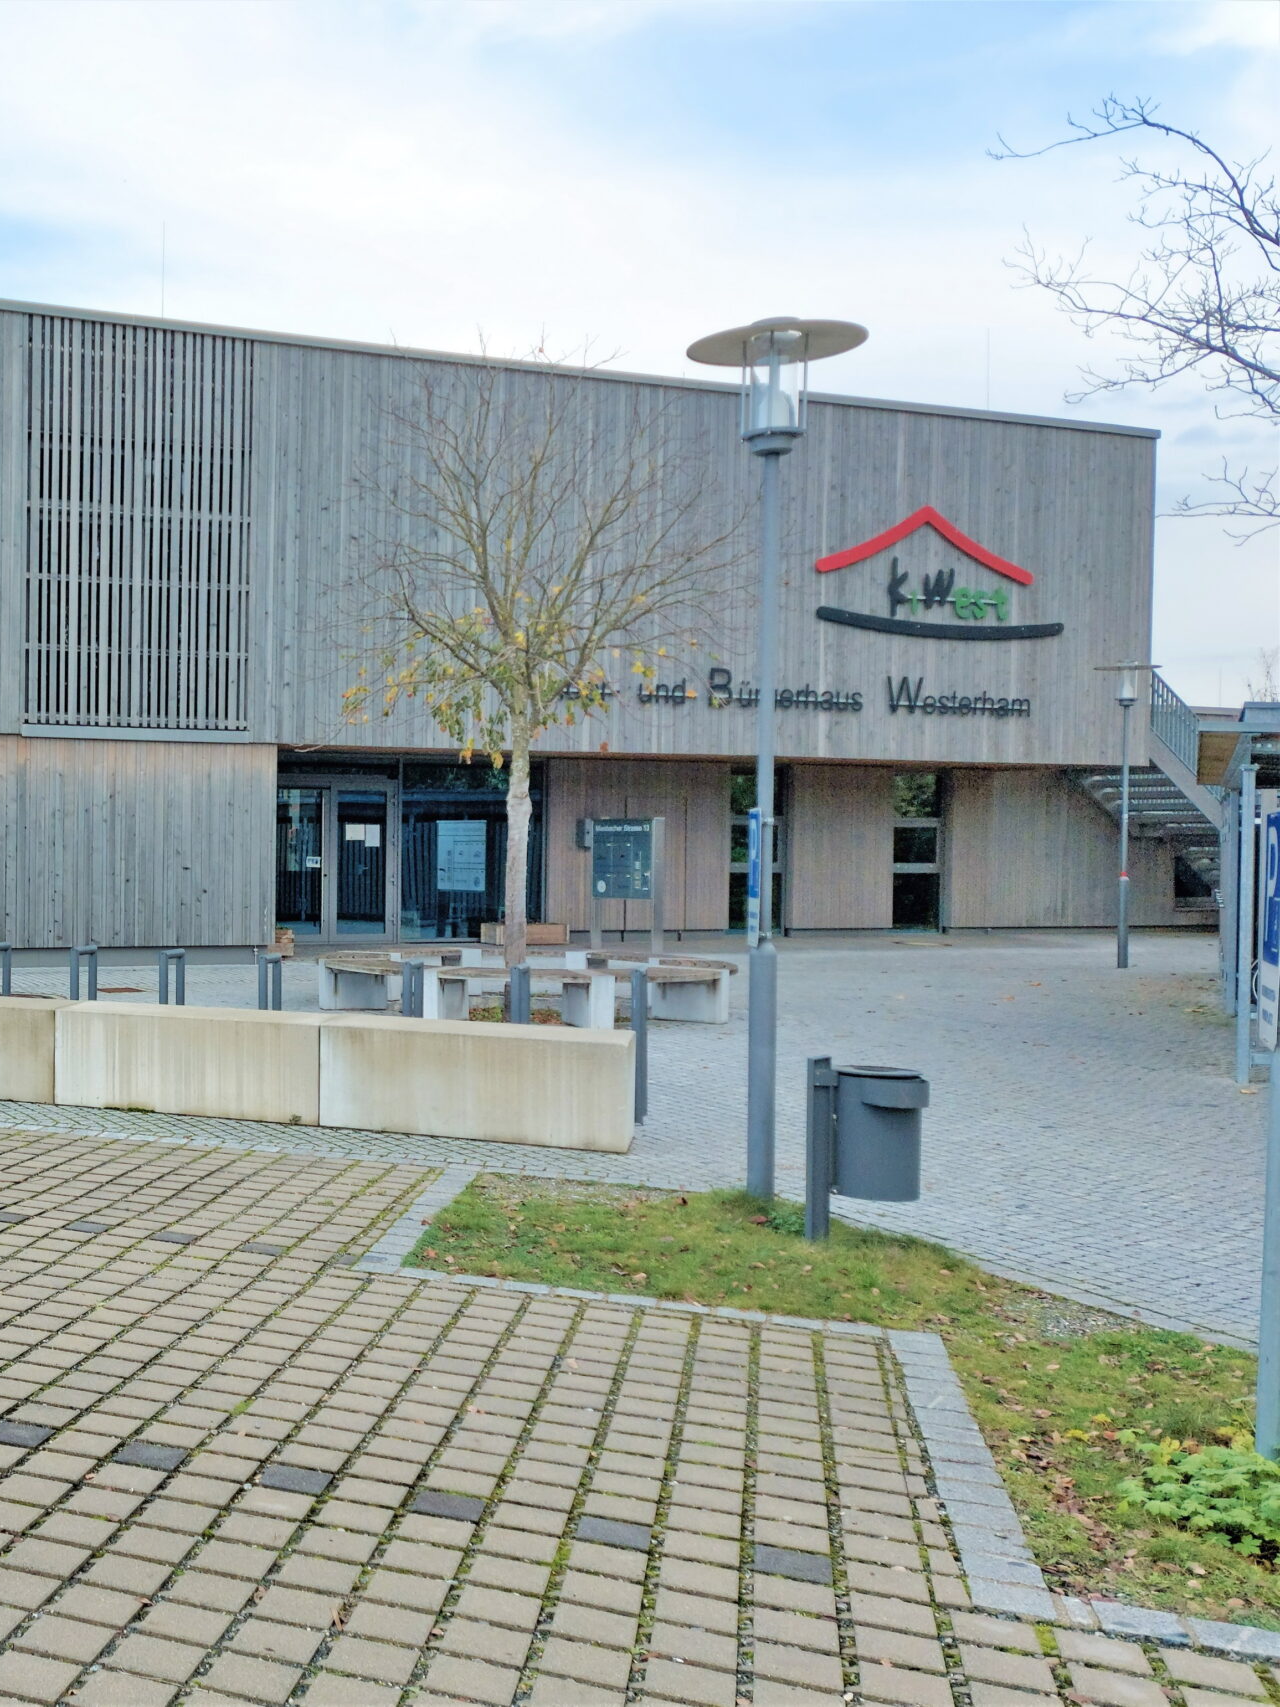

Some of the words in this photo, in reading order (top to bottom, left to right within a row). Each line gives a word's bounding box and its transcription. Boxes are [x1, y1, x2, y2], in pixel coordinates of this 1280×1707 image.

[638, 678, 687, 705] und
[708, 667, 863, 712] Bürerhaus
[887, 676, 1031, 717] Westerham
